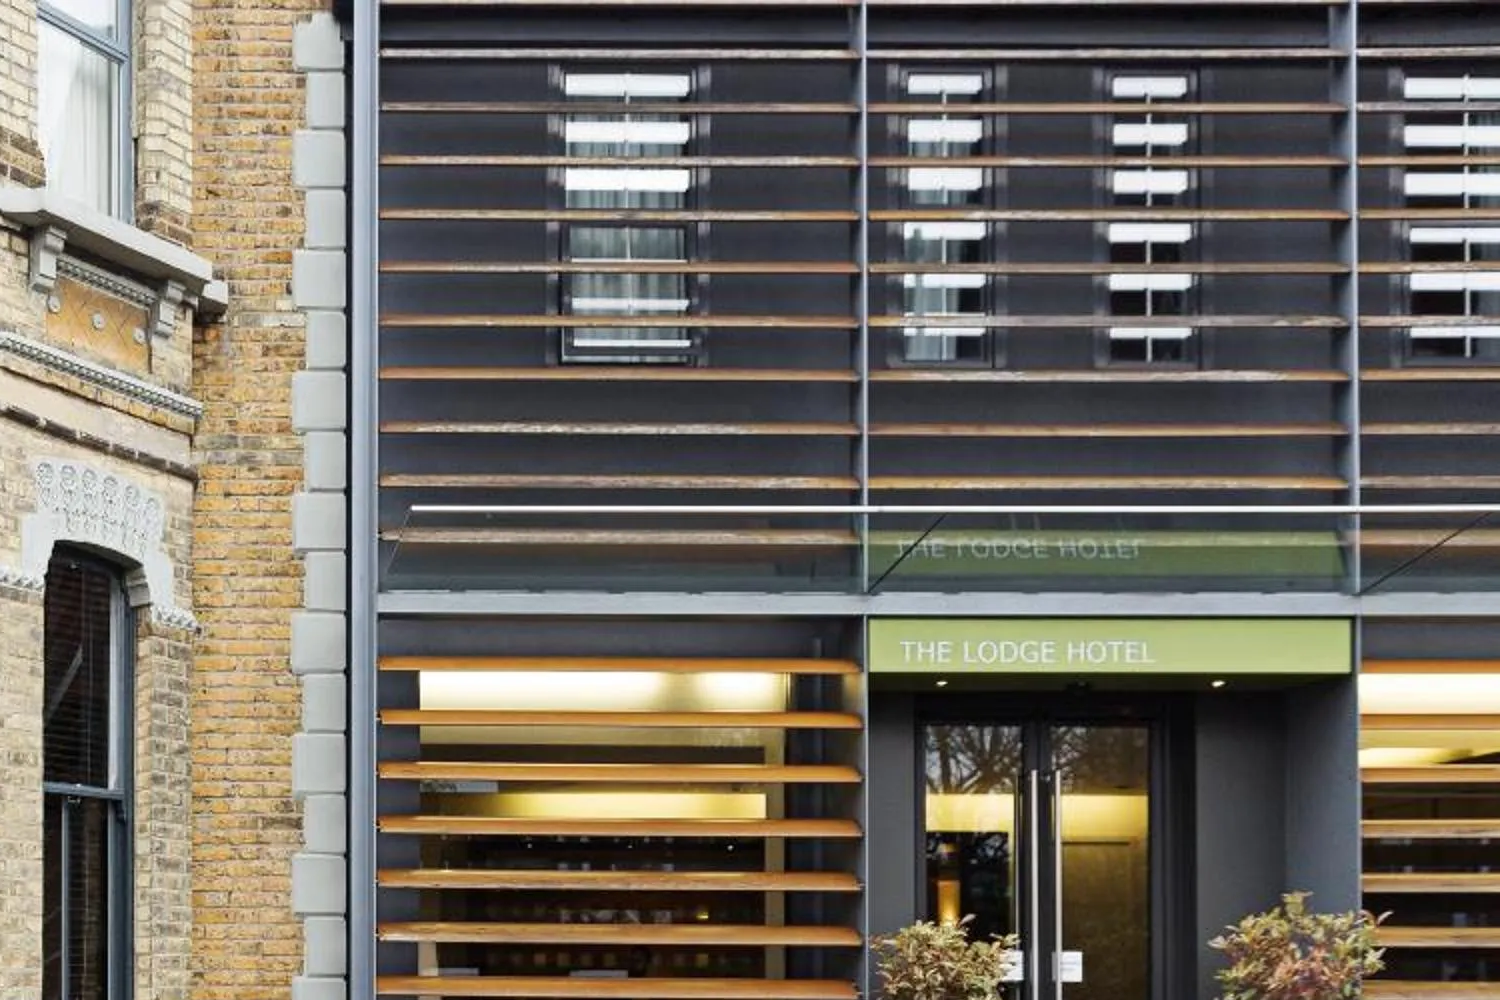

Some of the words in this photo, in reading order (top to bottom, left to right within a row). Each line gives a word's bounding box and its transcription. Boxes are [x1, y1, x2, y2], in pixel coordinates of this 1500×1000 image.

[899, 640, 953, 664] THE
[962, 640, 1056, 664] LODGE
[1067, 640, 1157, 664] HOTEL
